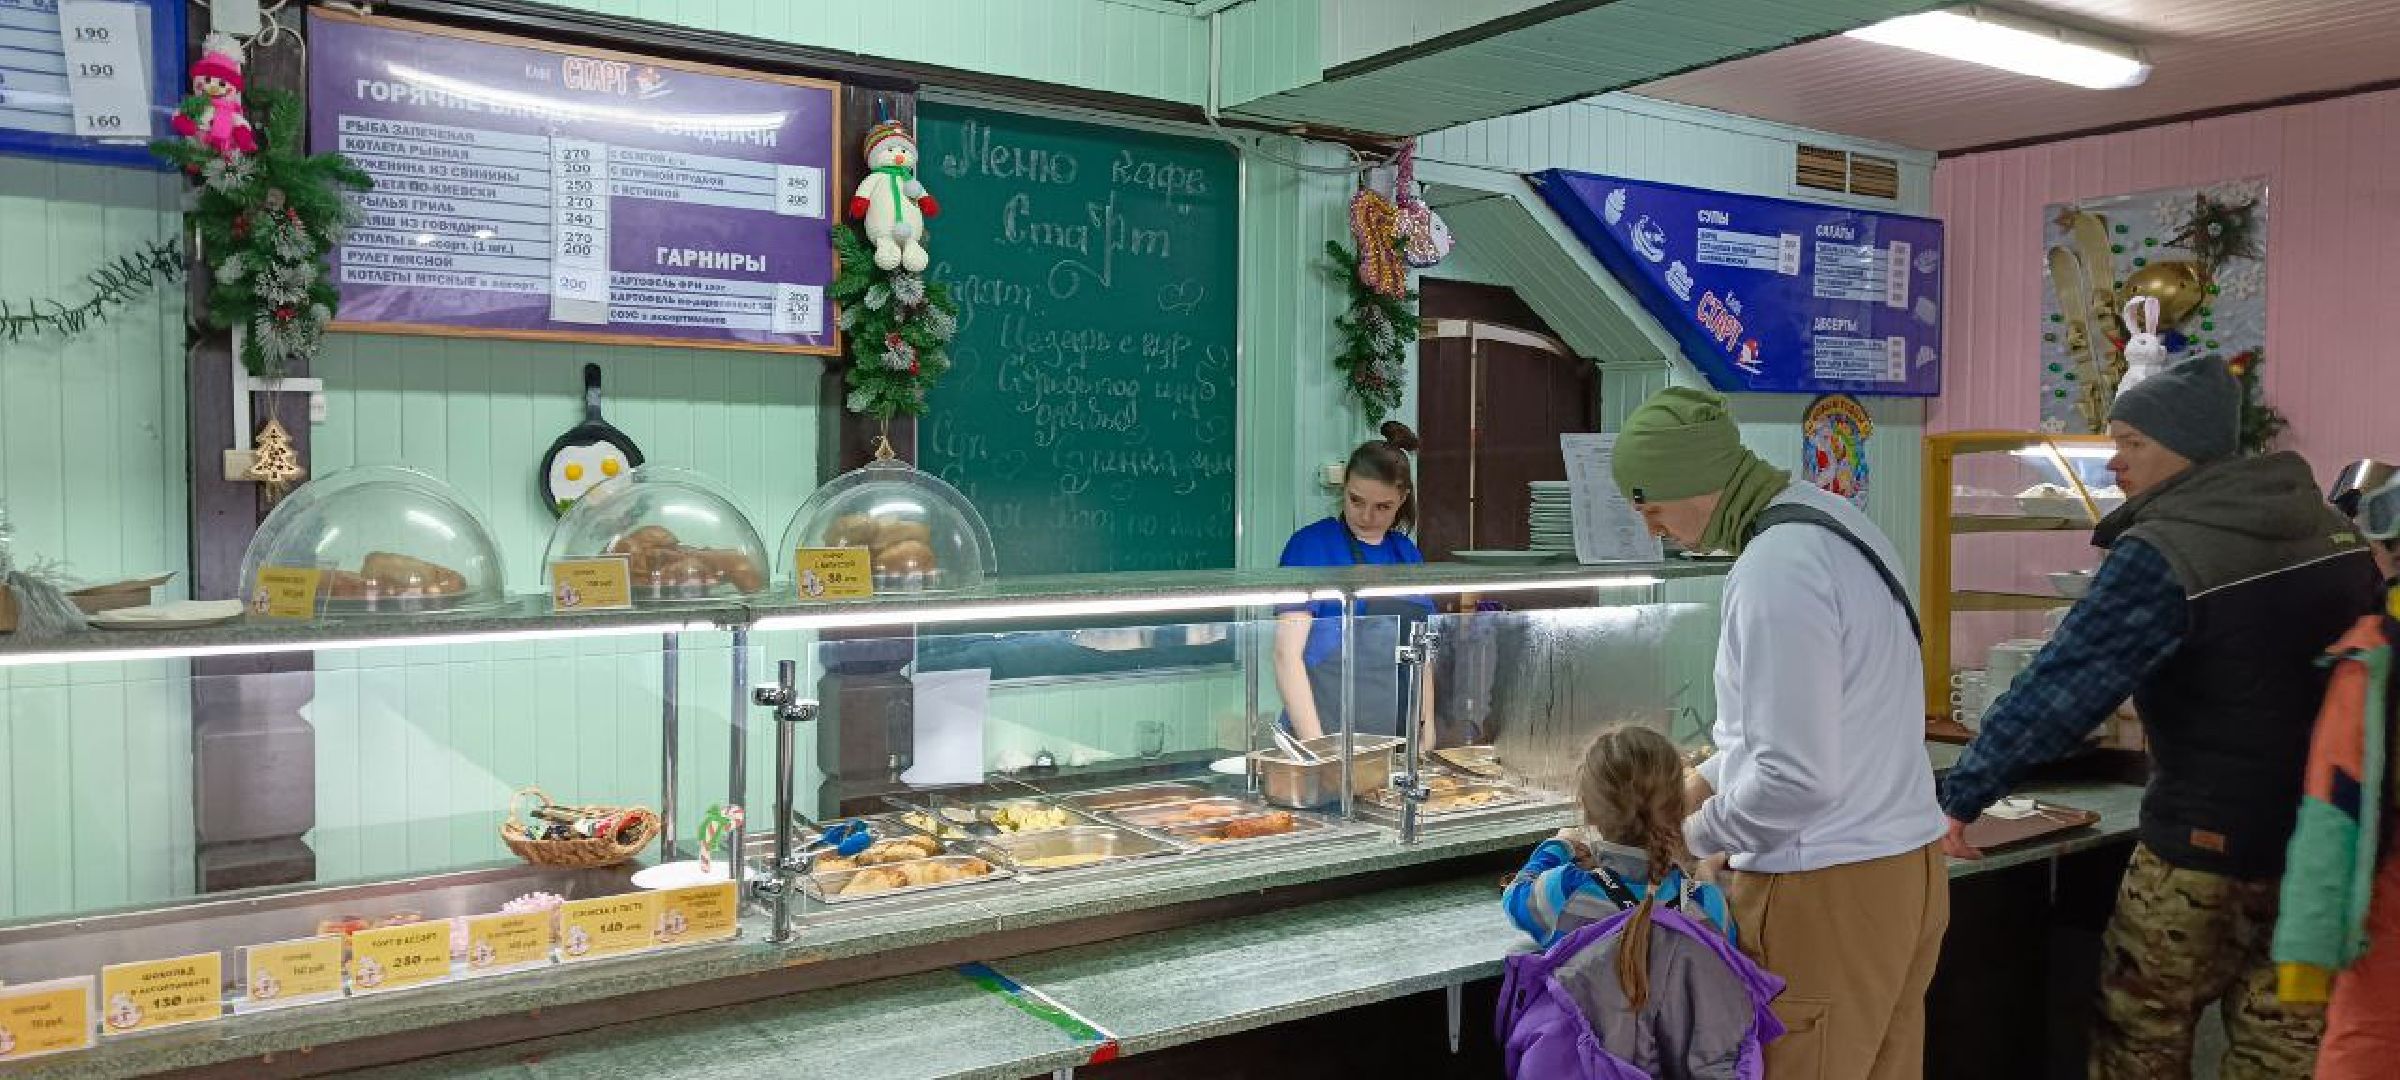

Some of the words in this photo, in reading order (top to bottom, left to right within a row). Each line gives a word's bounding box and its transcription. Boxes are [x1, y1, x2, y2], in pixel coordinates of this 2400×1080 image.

[74, 27, 109, 40] 190
[79, 63, 114, 77] 190
[562, 57, 631, 95] СТАРТ
[87, 115, 121, 128] 160
[345, 119, 389, 135] РЫБА
[345, 137, 406, 154] КОТЛЕТА
[411, 145, 469, 160] РЫБНАЯ
[942, 119, 1078, 184] Меню
[430, 165, 449, 177] ИЗ
[450, 166, 520, 183] СВИНИНЫ
[409, 180, 497, 199] ПО-КИЕВСКИ
[411, 199, 456, 213] ГРИЛЬ
[400, 216, 418, 229] ИЗ
[422, 218, 499, 235] ГОВЯДИНЫ
[1697, 209, 1729, 226] СУПЫ
[347, 232, 404, 247] КУПАТЫ
[1815, 224, 1855, 241] САЛАТЫ
[347, 251, 389, 265] РУЛЕТ
[391, 253, 454, 268] МЯСНОЙ
[656, 246, 767, 272] ГАРНИРЫ
[346, 269, 412, 283] КОТЛЕТЫ
[610, 275, 677, 290] КАРТОФЕЛЬ
[677, 279, 703, 291] ФРИ
[610, 291, 677, 305] КАРТОФЕЛЬ
[610, 310, 640, 321] СОУС
[1814, 317, 1857, 332] ДЕСЕРТЫ
